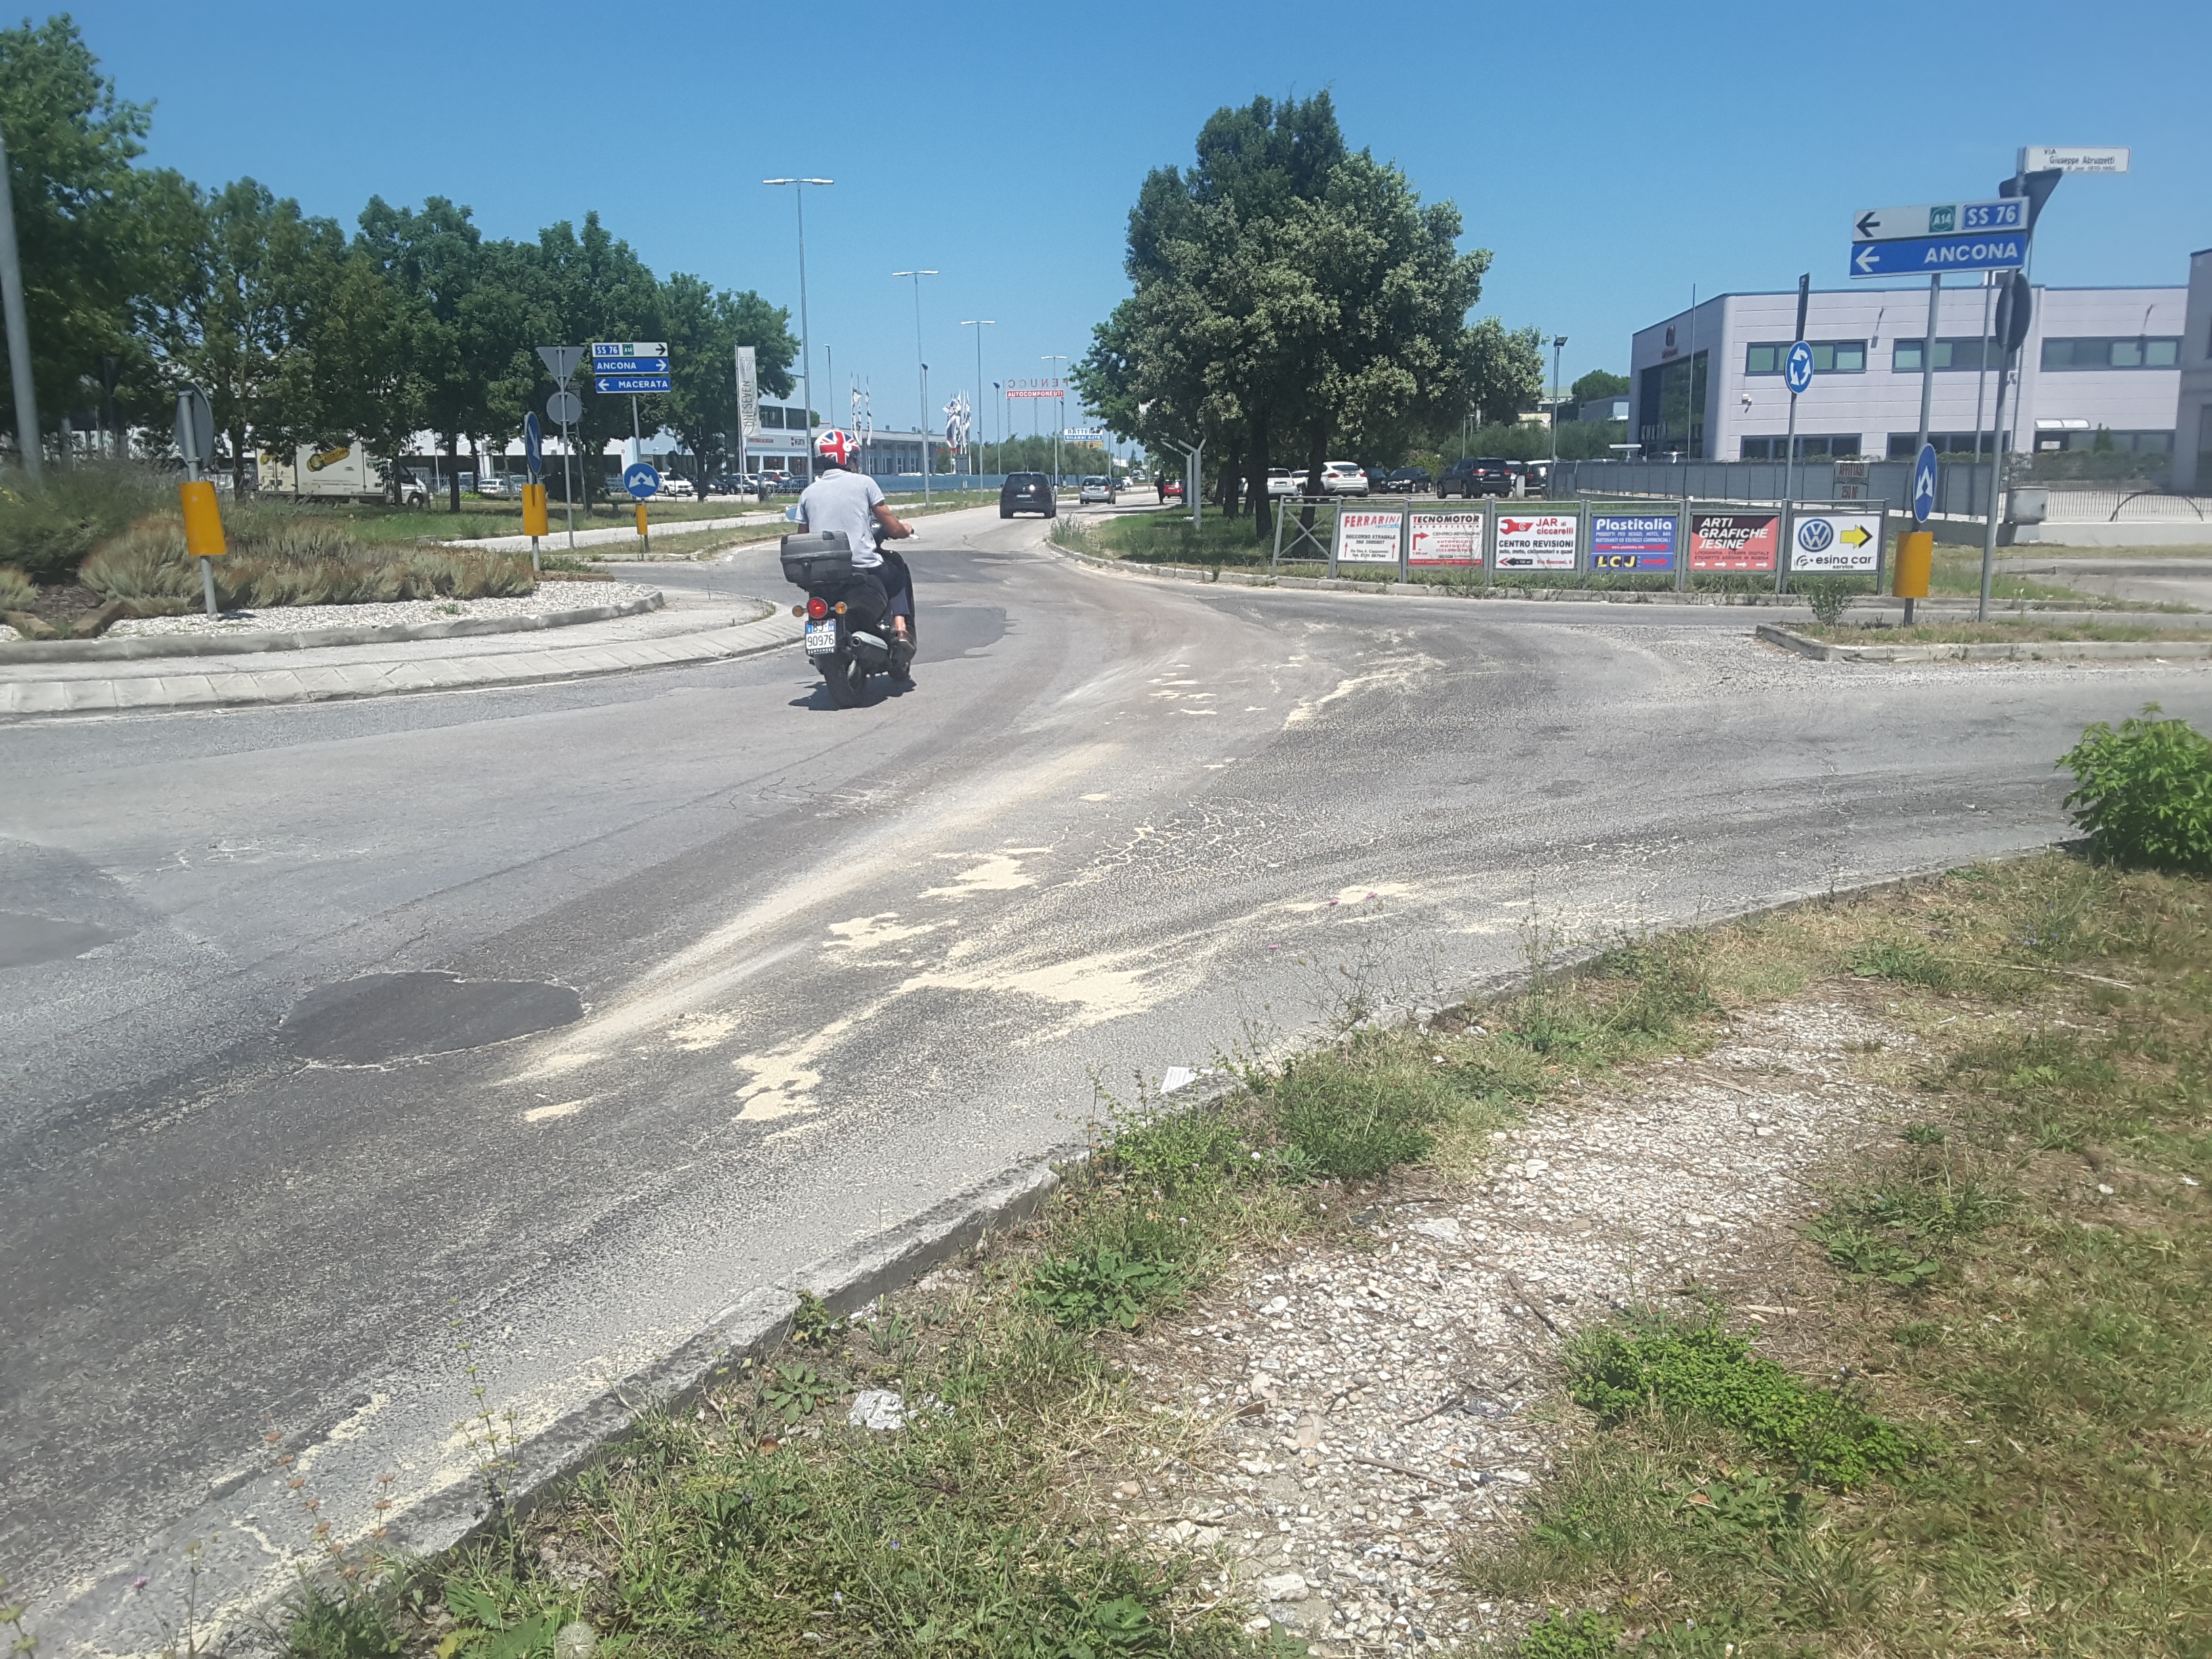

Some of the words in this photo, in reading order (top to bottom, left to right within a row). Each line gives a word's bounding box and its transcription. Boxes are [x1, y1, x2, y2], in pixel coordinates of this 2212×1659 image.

[2049, 156, 2079, 165] Giuseppe
[1933, 213, 1952, 225] A14
[1967, 207, 1990, 226] SS
[1996, 205, 2017, 224] 76
[1923, 242, 2019, 264] ANCONA
[596, 346, 607, 354] SS
[609, 346, 618, 354] 76
[596, 361, 637, 370] ANCONA
[618, 380, 668, 389] MACERATA
[1344, 516, 1400, 528] FERRARINI
[1413, 515, 1479, 523] TECNOMOTOR
[1536, 518, 1558, 527] JAR
[1701, 518, 1734, 527] ARTI
[1596, 518, 1672, 530] Plastitalia
[1699, 529, 1768, 538] GRAFICHE
[1699, 539, 1745, 549] JESINE
[813, 621, 823, 632] BJ
[807, 634, 834, 647] 90976
